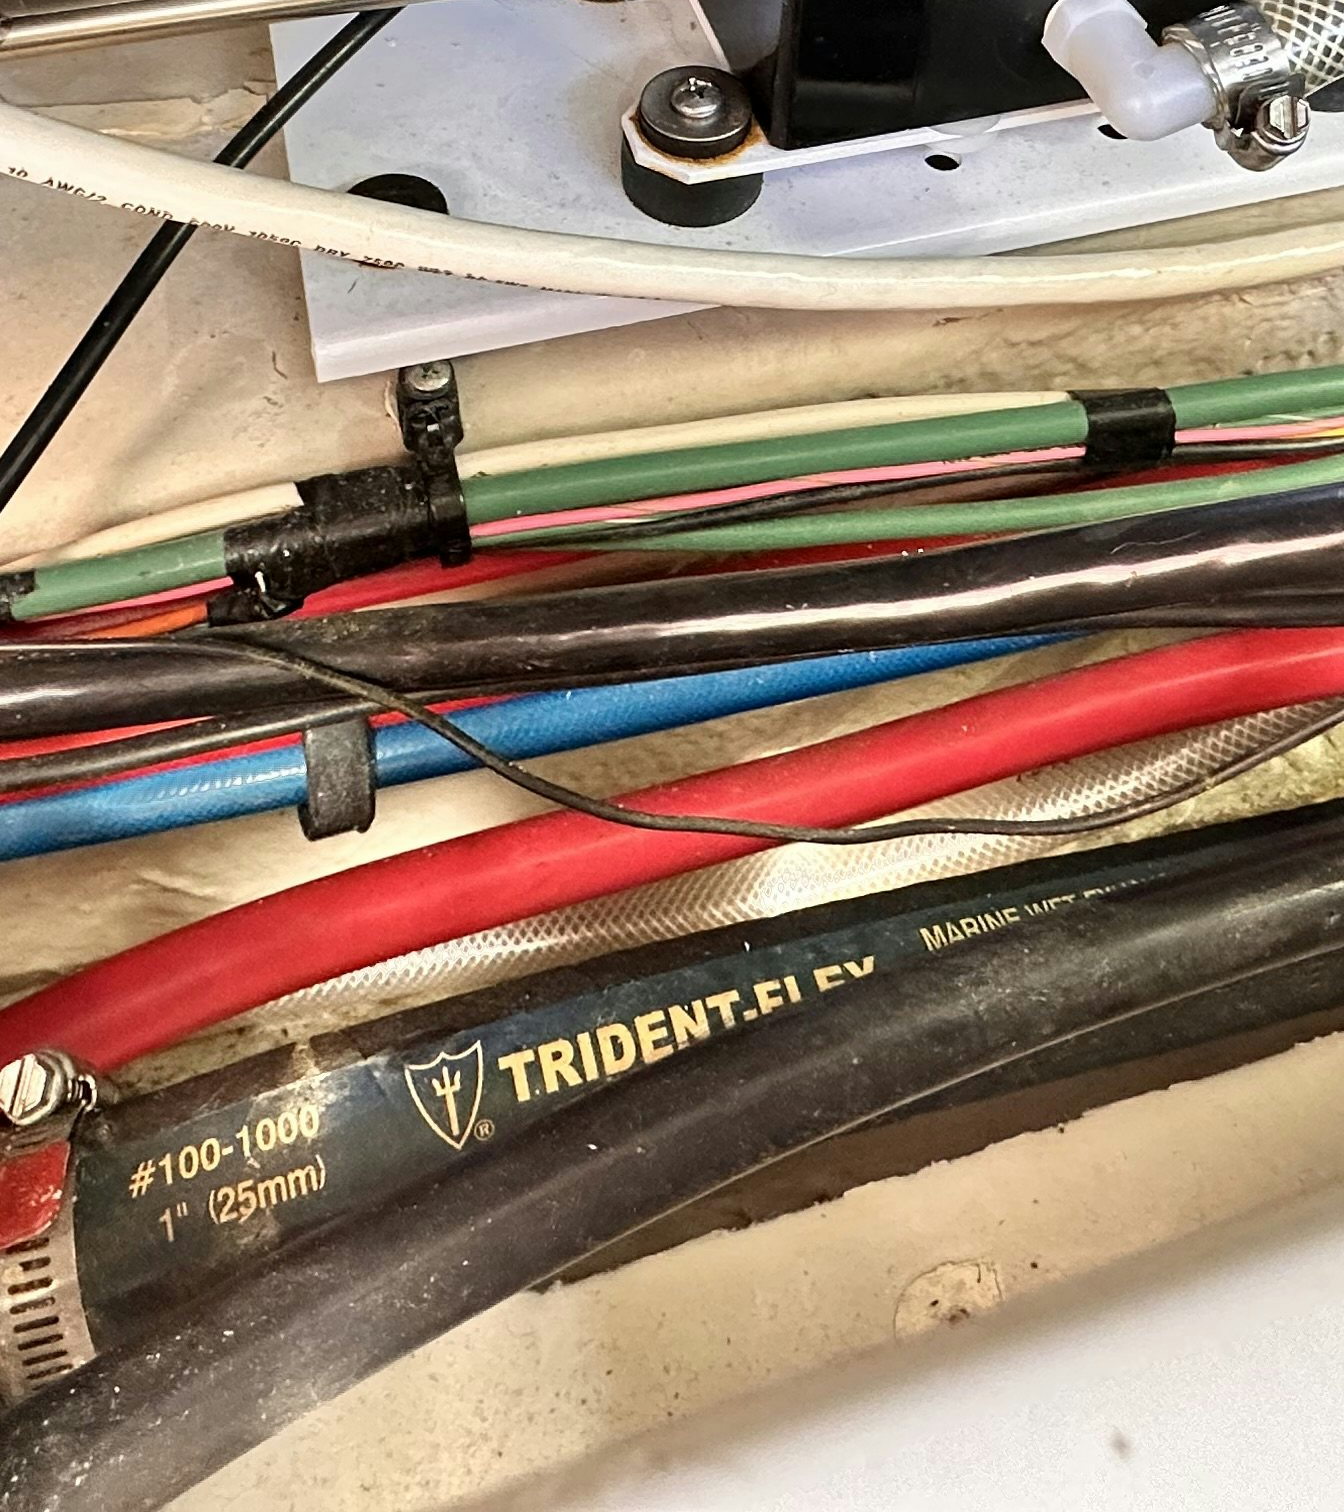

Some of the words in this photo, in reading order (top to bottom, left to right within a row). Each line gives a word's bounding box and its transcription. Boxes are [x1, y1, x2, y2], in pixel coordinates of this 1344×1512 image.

[919, 906, 1021, 952] MARINE
[128, 1104, 320, 1199] #100-1000
[159, 1200, 188, 1243] 1"
[208, 1154, 327, 1225] (25mm)
